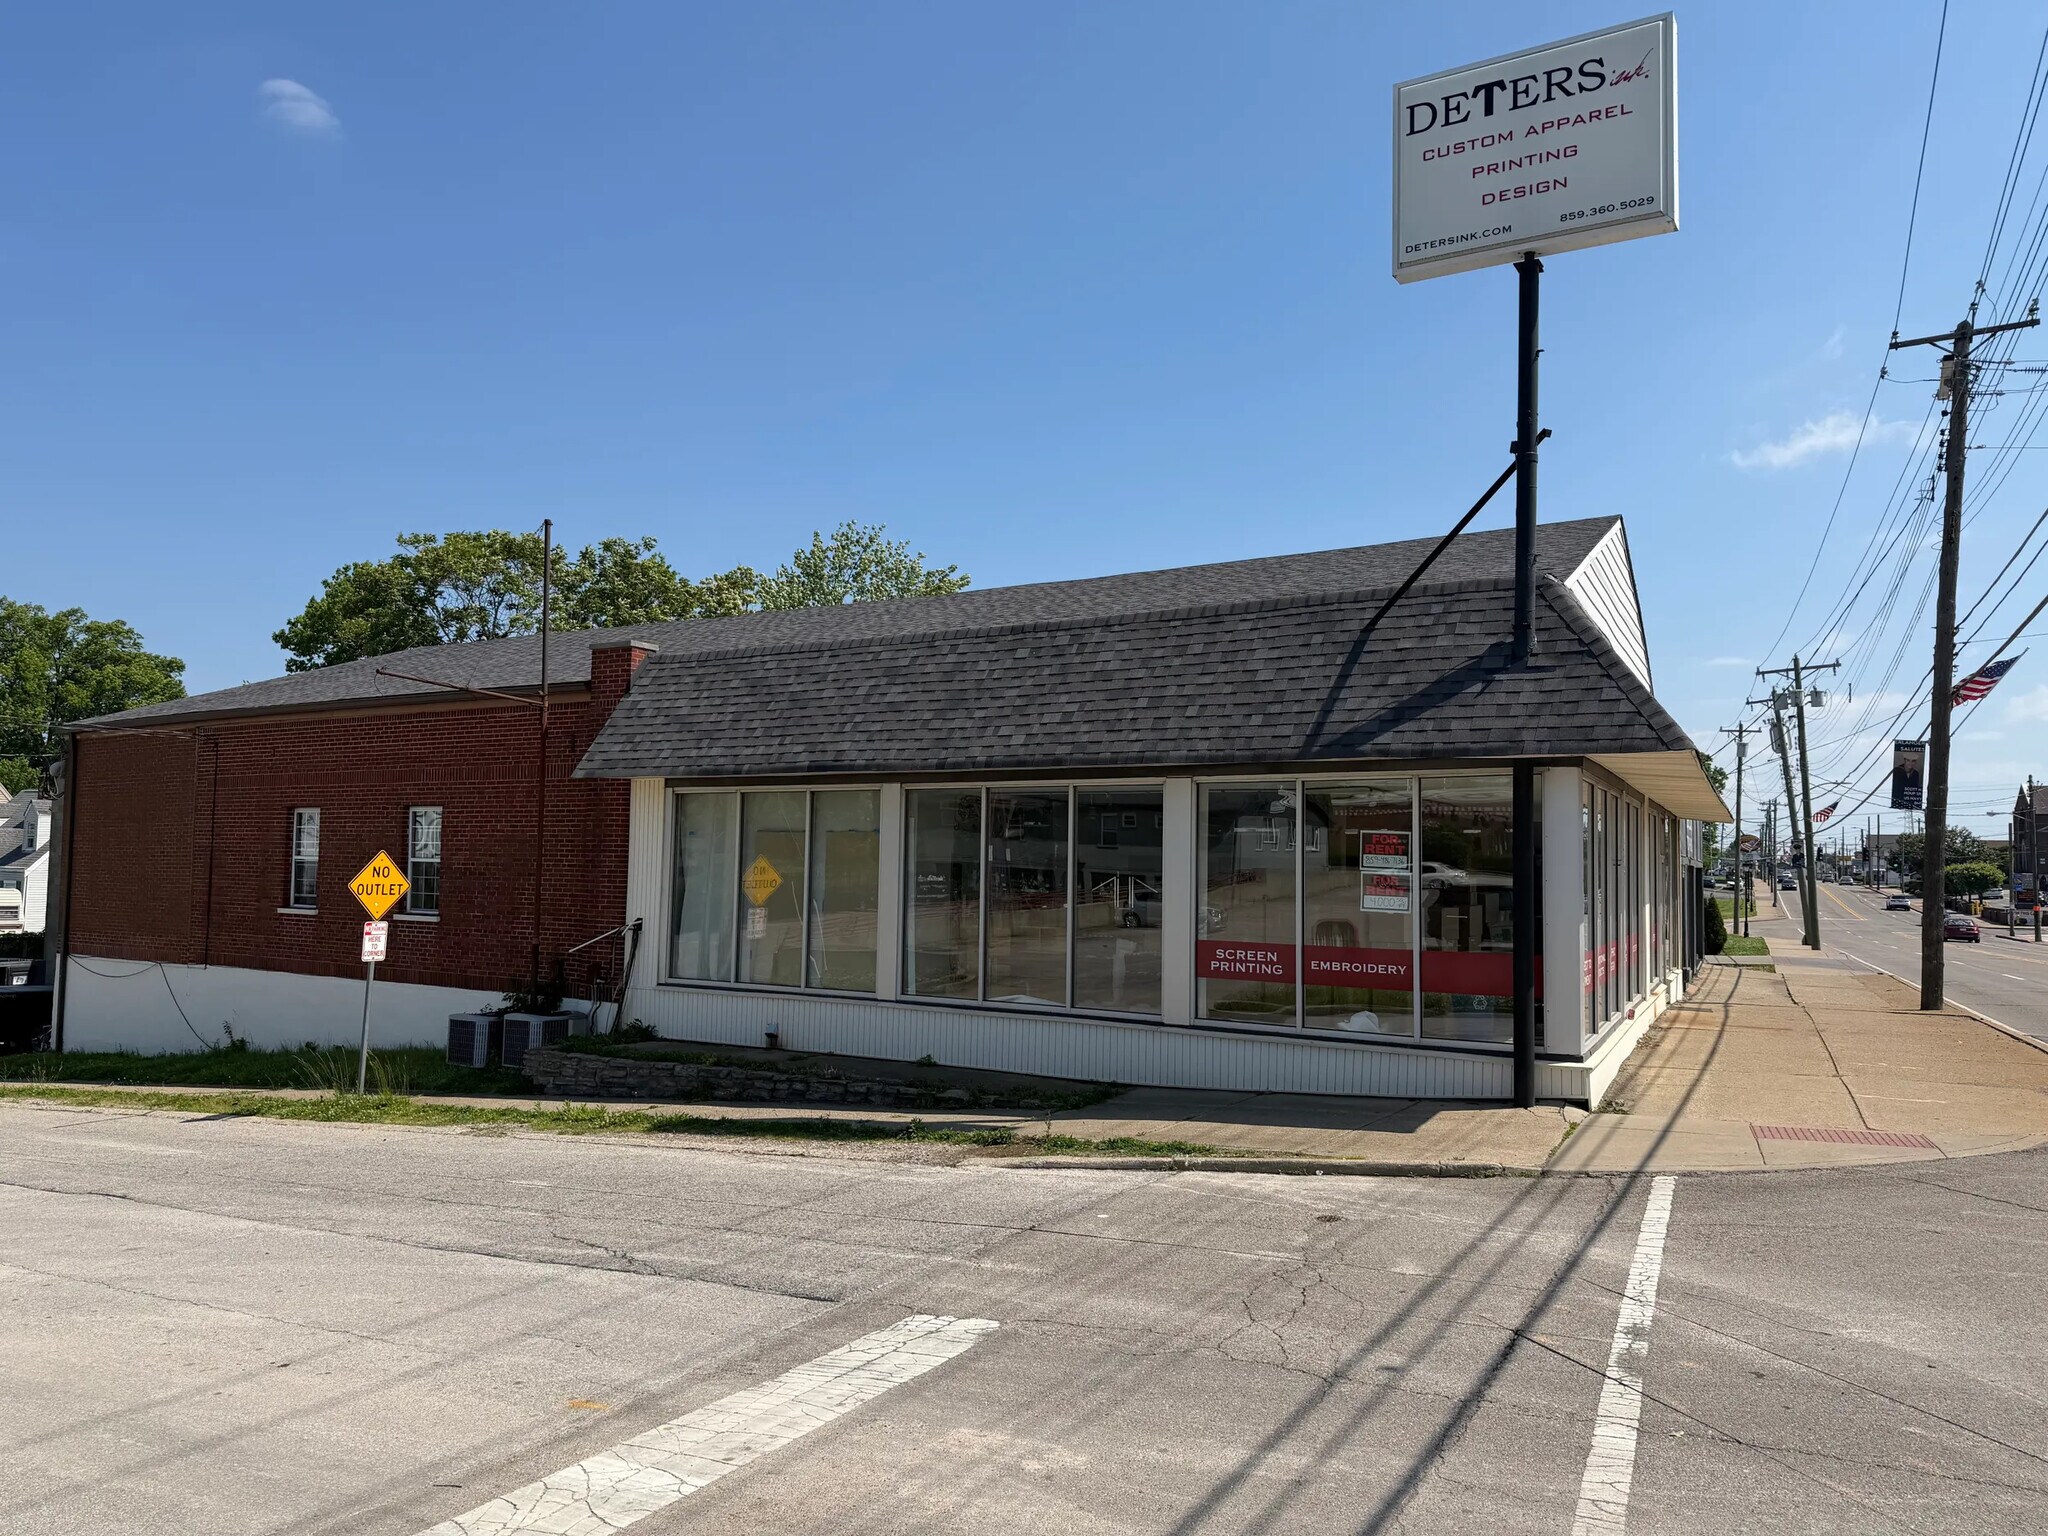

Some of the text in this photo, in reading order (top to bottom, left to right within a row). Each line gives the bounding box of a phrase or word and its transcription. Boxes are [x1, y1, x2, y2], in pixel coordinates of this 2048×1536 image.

[1406, 57, 1607, 136] DETERS
[1423, 104, 1633, 161] CUSTOM APPAREL
[1472, 145, 1578, 178] PRINTING
[1482, 177, 1568, 206] DESIGN
[1560, 196, 1655, 222] 859.360.5029
[1405, 225, 1512, 253] DETERSINK.COM
[1372, 834, 1399, 844] FOR
[1365, 844, 1405, 855] RENT
[372, 866, 390, 878] NO
[1372, 875, 1399, 886] FOR
[357, 884, 403, 895] OUTLET
[1366, 885, 1406, 896] RENT
[1216, 949, 1277, 962] SCREEN
[1210, 961, 1283, 975] PRINTING
[1311, 960, 1407, 975] EMBROIDERY
